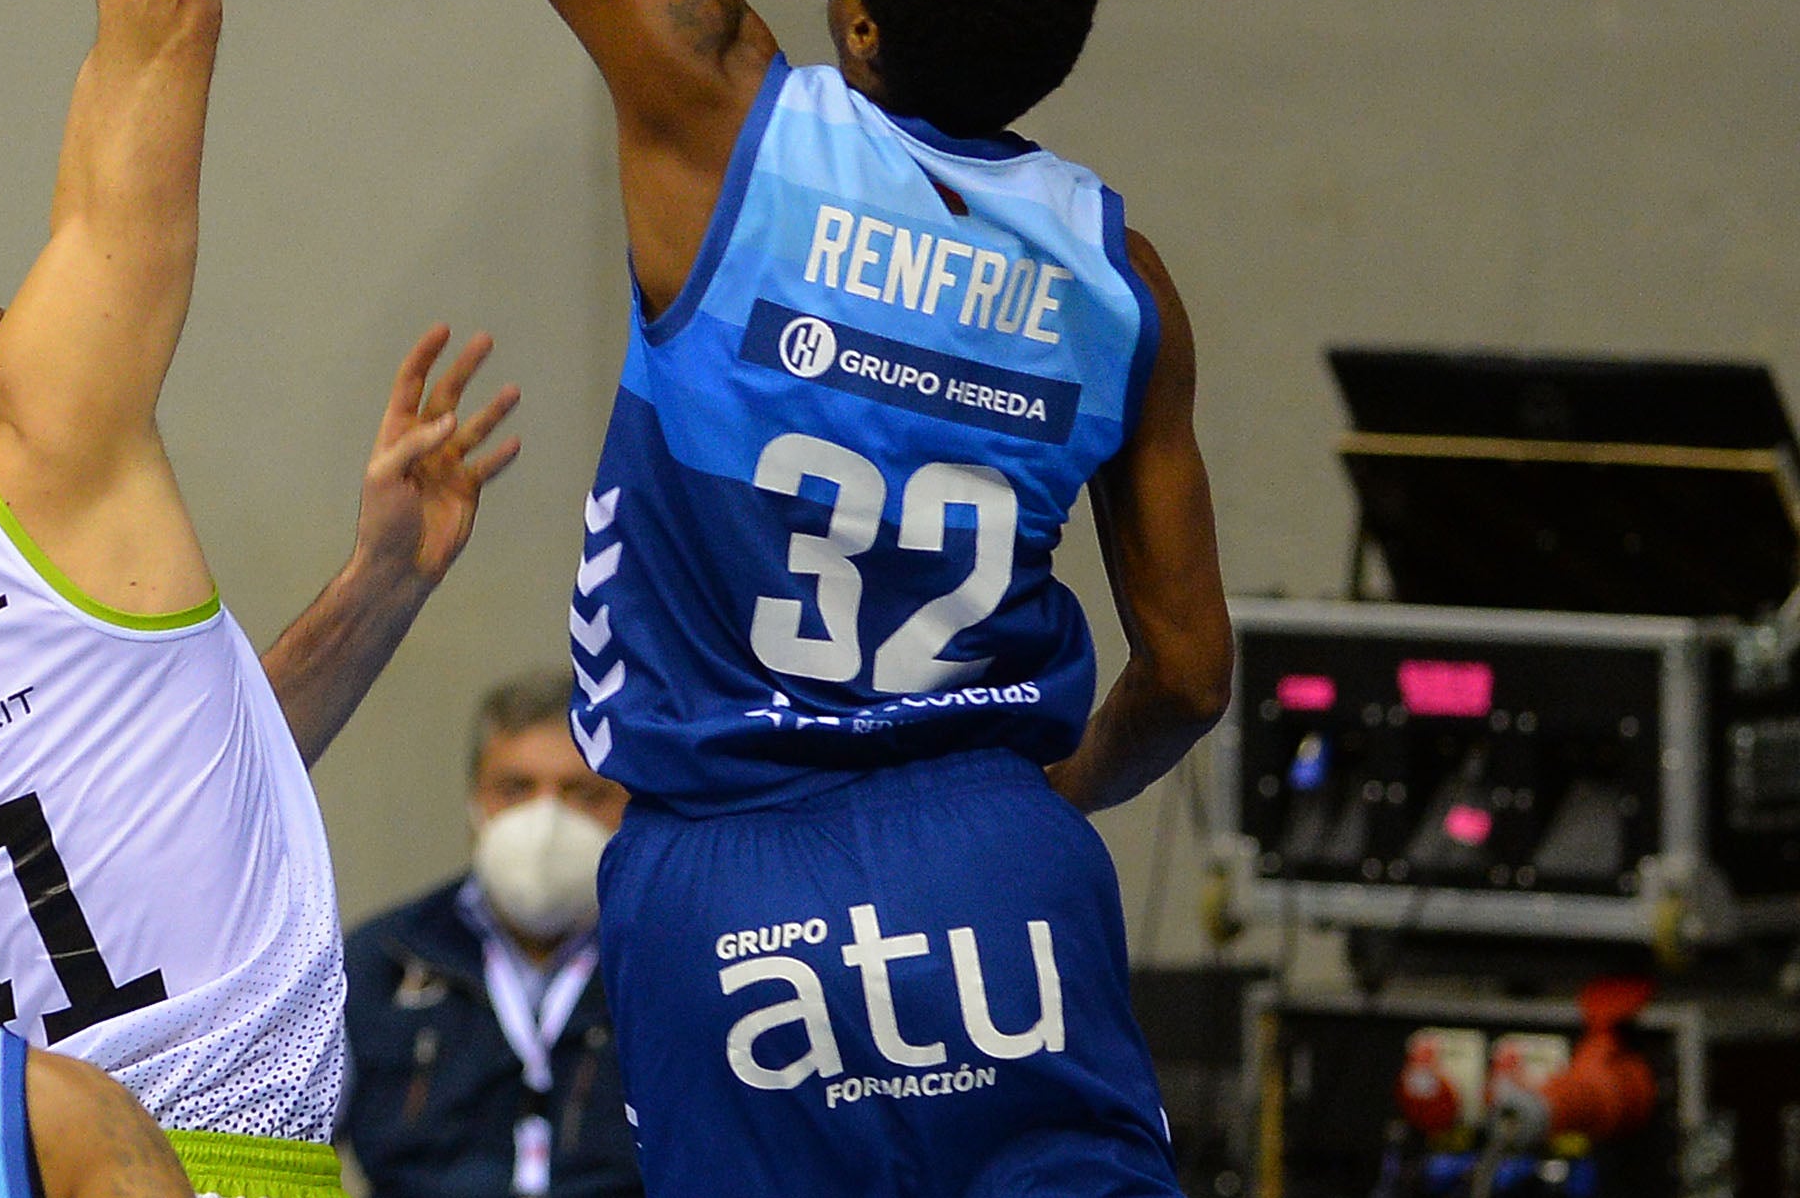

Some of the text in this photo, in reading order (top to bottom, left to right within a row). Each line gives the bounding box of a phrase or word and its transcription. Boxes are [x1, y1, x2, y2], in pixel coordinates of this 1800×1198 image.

[804, 205, 1075, 345] RENFROE
[839, 350, 941, 396] GRUPO
[945, 378, 1047, 422] HEREDA
[750, 432, 1017, 693] 32
[716, 918, 828, 960] GRUPO
[718, 903, 1065, 1090] atu
[826, 1063, 997, 1109] FORMACIÓN
